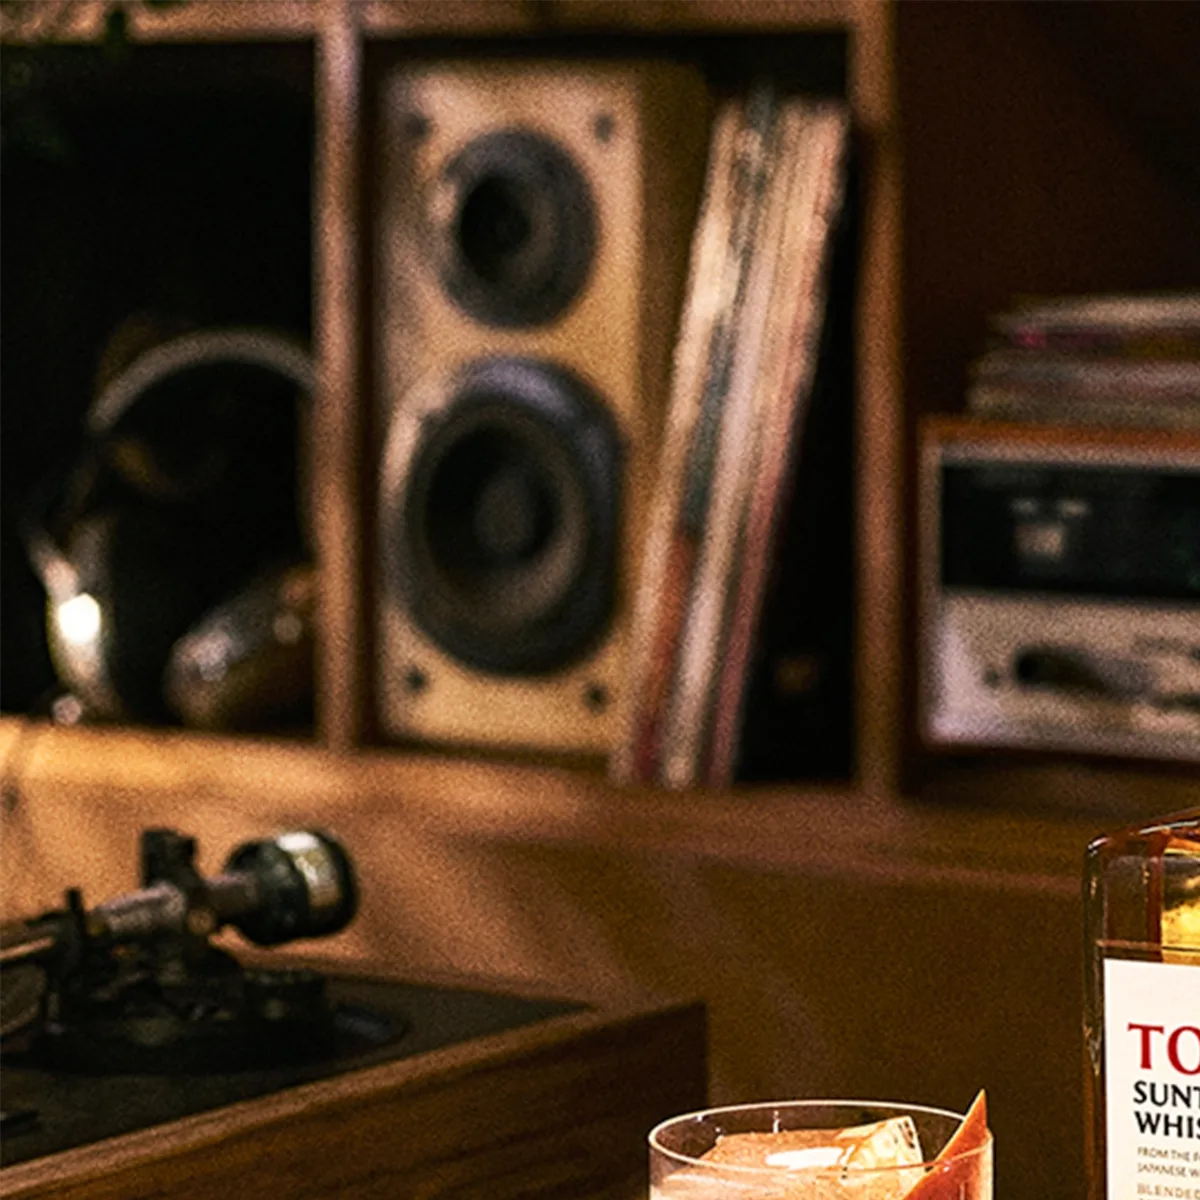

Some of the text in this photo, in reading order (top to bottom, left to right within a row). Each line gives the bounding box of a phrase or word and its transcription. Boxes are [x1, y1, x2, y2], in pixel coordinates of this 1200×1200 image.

[1137, 1146, 1168, 1158] FROM
[1171, 1150, 1190, 1161] THE
[1137, 1162, 1187, 1177] JAPANESE
